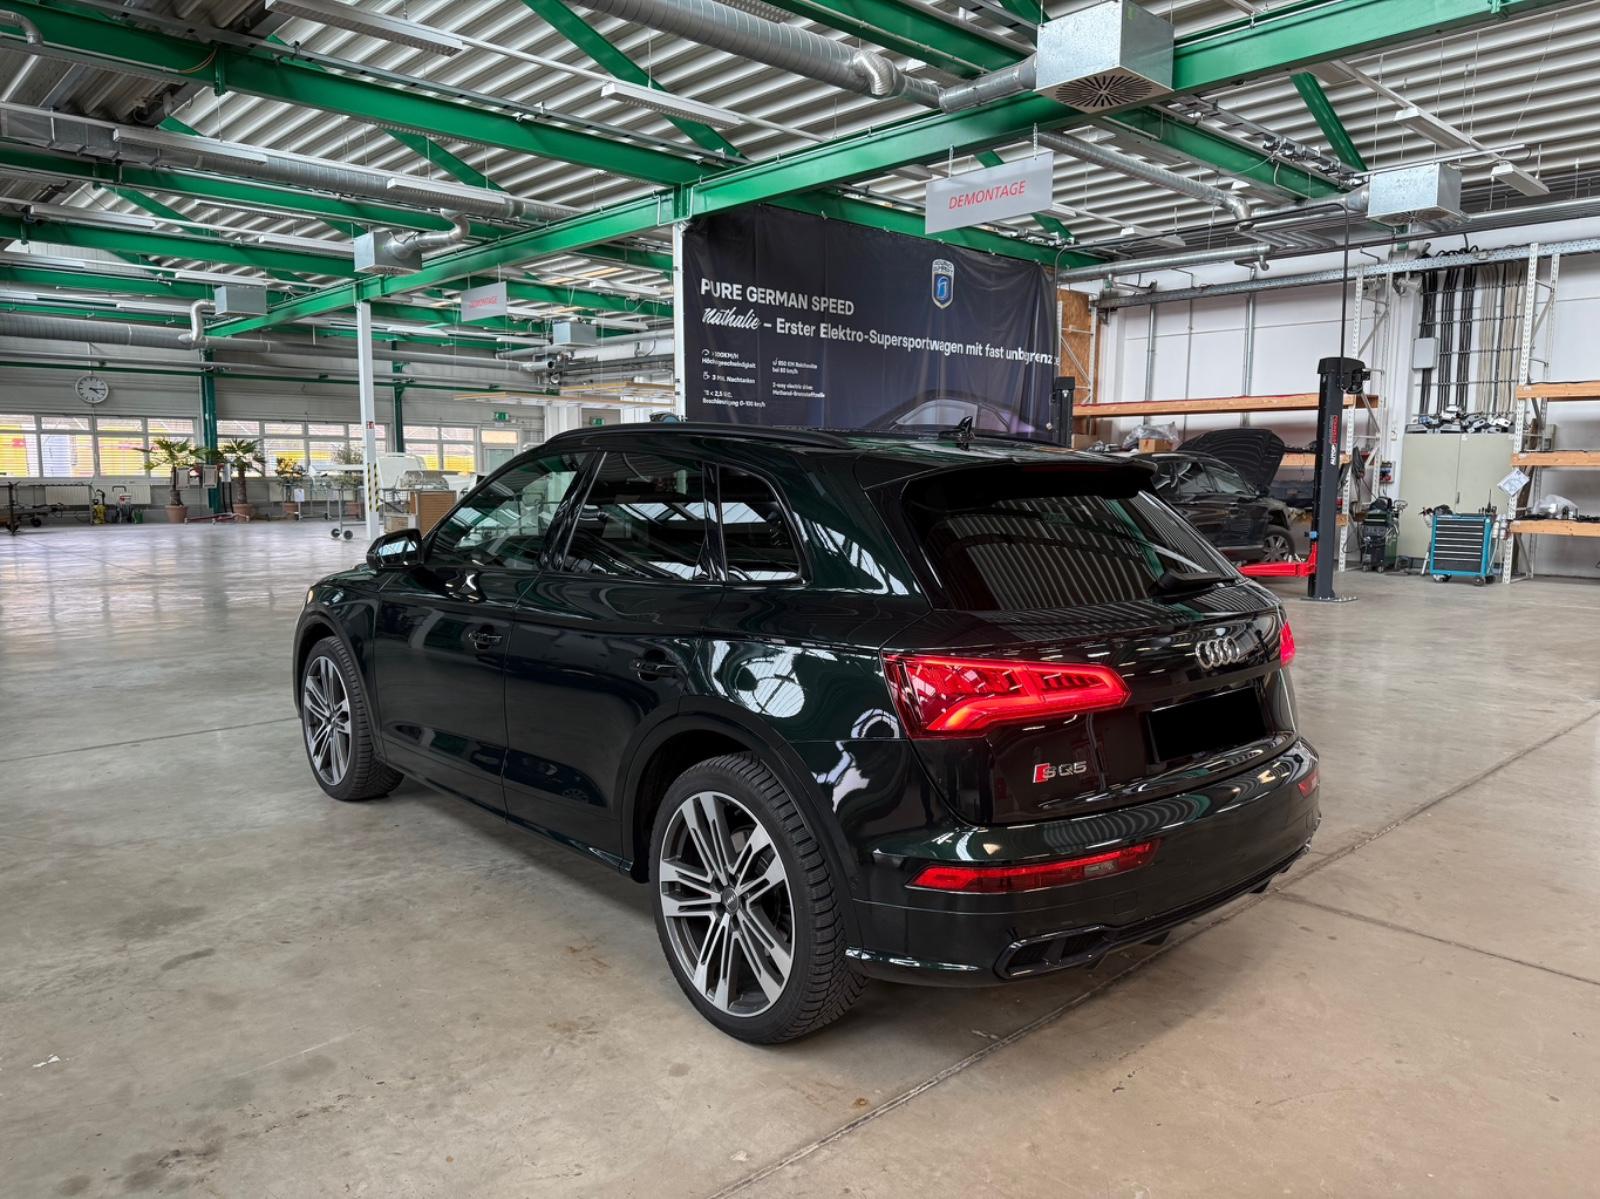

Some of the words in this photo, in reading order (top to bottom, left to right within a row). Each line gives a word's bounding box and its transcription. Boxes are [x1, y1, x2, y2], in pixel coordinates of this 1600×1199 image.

[948, 180, 1026, 210] DEMONTAGE
[701, 278, 743, 301] PURE
[746, 286, 809, 310] GERMAN
[811, 296, 855, 315] SPEED
[702, 307, 761, 330] Nathalie
[776, 317, 816, 337] Erster
[820, 323, 963, 356] Elektro-Supersportwagen
[966, 342, 983, 356] mit
[985, 344, 1004, 359] fast
